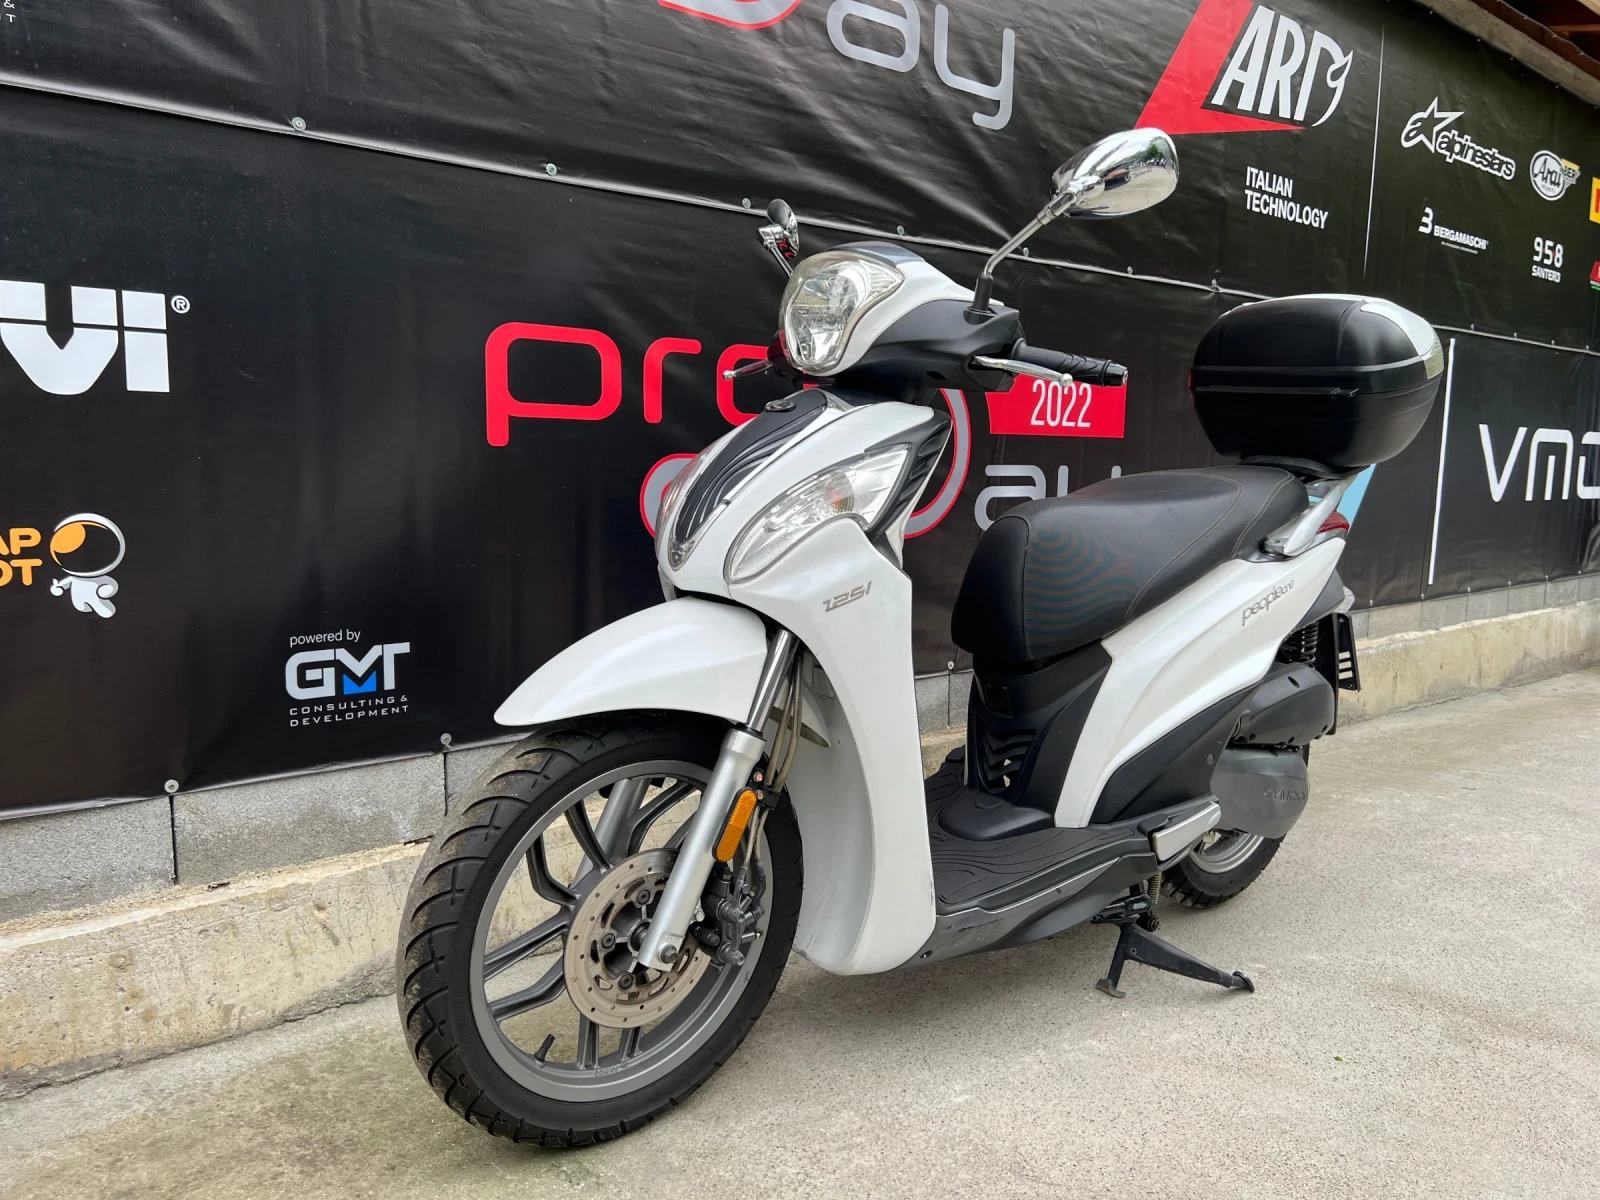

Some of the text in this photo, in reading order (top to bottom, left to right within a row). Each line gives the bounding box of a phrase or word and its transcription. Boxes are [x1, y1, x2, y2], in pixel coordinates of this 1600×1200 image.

[1246, 166, 1293, 198] ITALIAN
[1245, 189, 1328, 229] TECHNOLOGY
[1433, 225, 1487, 250] BERGAMASCHI
[1533, 236, 1563, 268] 958
[1031, 379, 1092, 428] 2022
[289, 628, 361, 648] powered by
[285, 641, 411, 700] GMT
[289, 694, 408, 716] CONSULTING &
[289, 705, 409, 728] DEVELOPMENT
